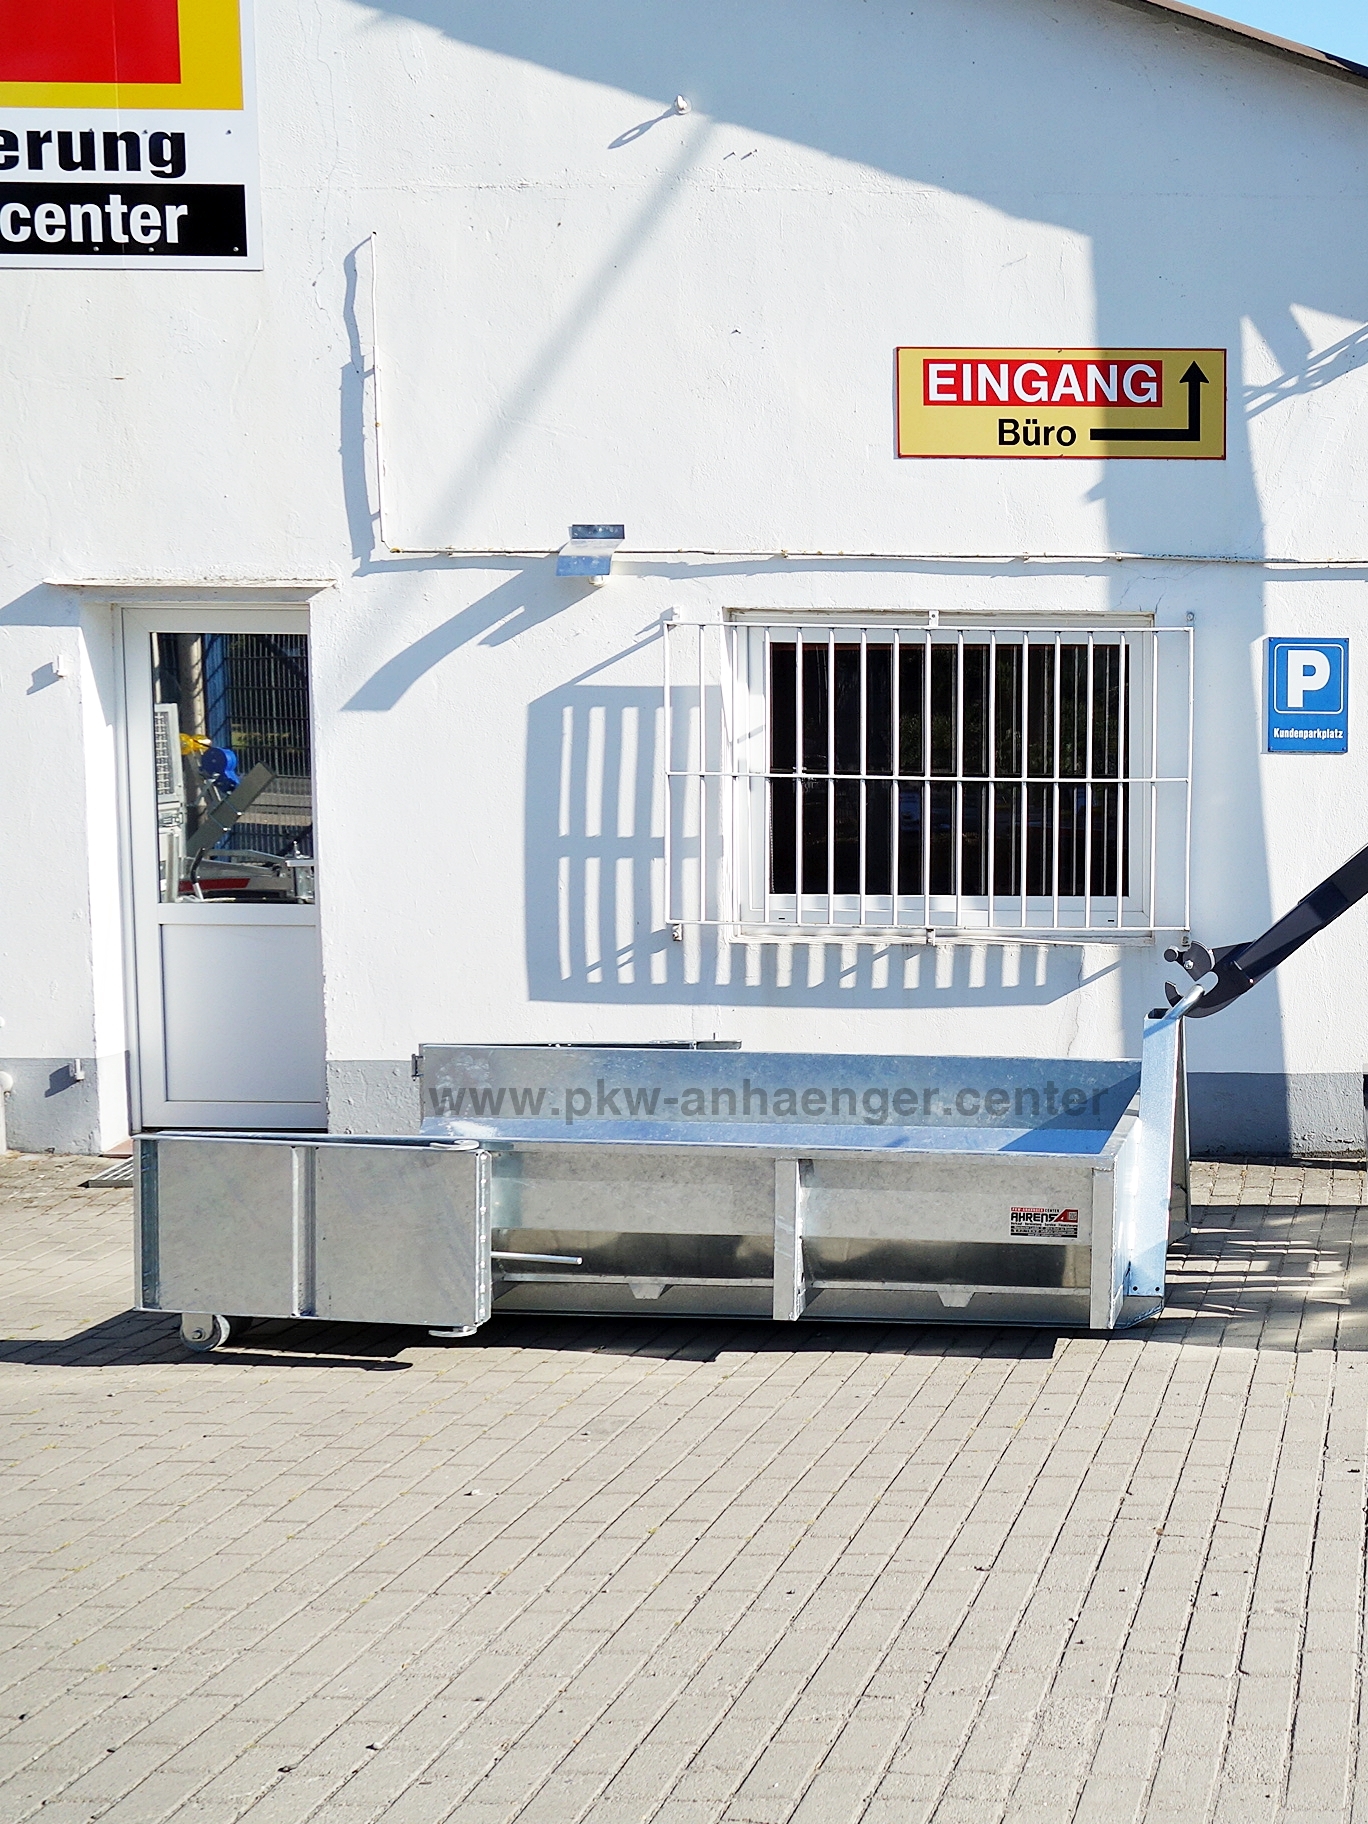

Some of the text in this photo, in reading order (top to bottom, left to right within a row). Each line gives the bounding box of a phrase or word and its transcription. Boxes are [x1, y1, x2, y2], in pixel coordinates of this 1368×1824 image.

[928, 363, 1158, 404] EINGANG
[998, 418, 1077, 447] Büro
[1287, 649, 1331, 708] P
[1273, 727, 1344, 740] Kundenparkplatz
[1011, 1212, 1059, 1223] AHRENS
